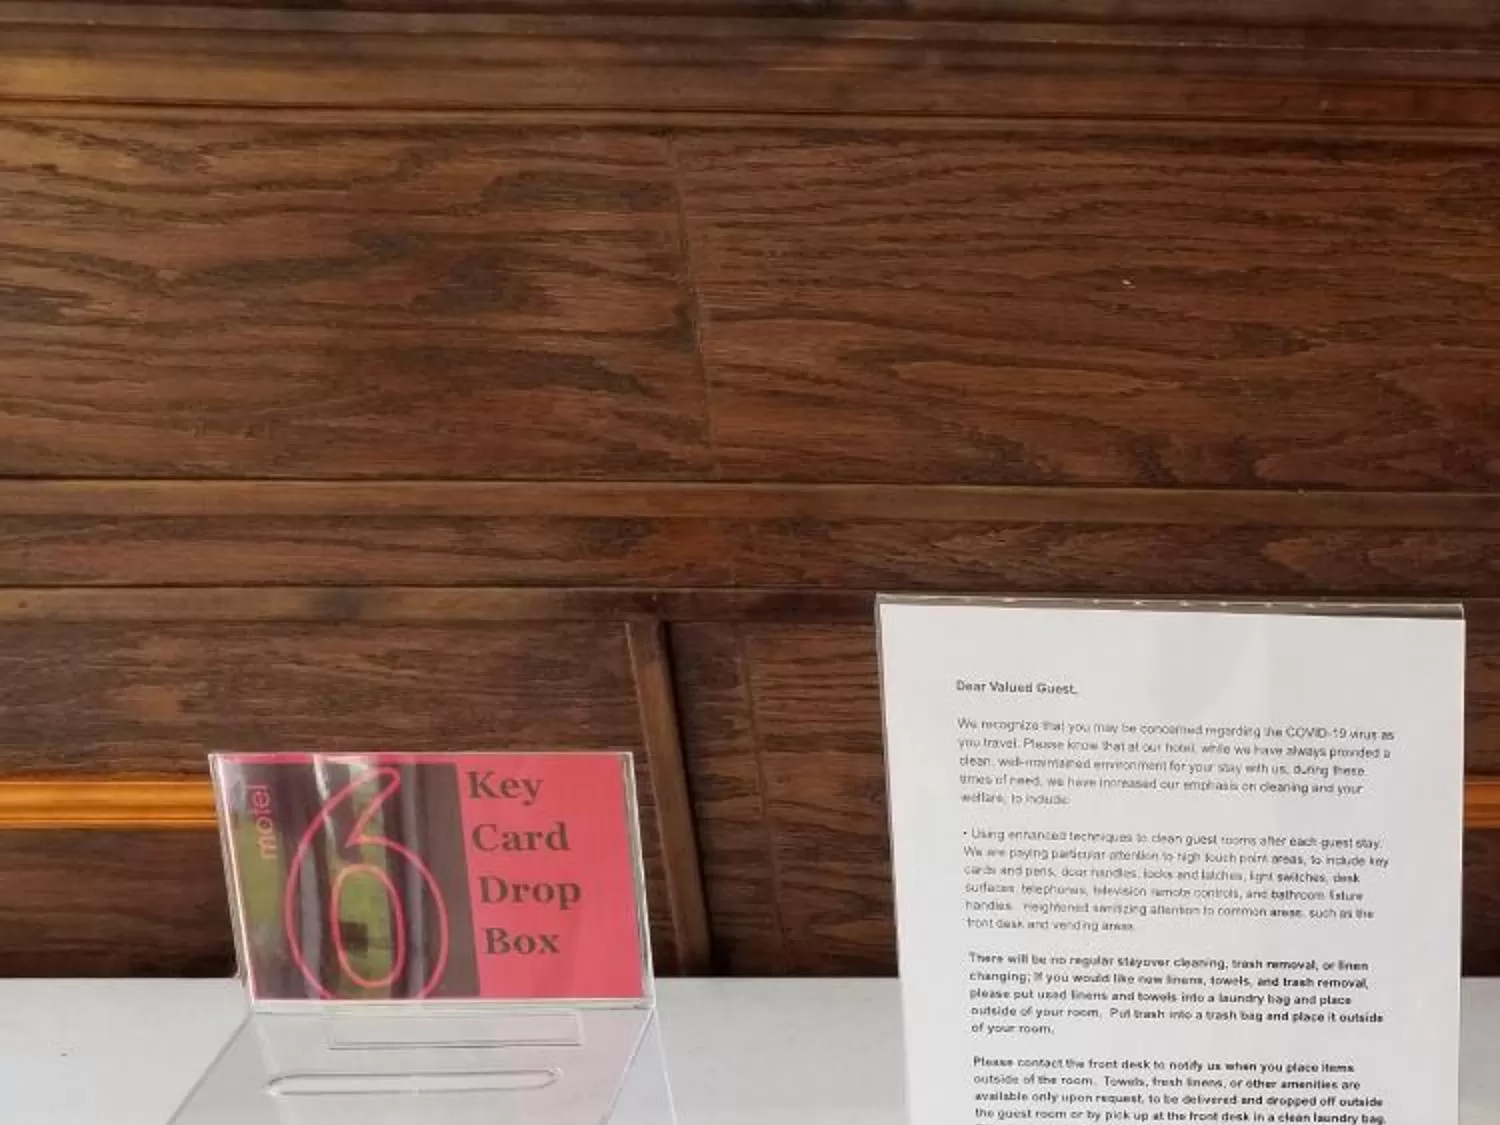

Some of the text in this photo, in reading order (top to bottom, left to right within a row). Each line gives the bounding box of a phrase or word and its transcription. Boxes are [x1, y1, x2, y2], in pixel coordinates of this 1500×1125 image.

[956, 680, 986, 691] Dear
[989, 682, 1032, 692] Valued
[465, 769, 544, 806] Key
[249, 785, 278, 860] motel
[472, 821, 570, 852] Card
[285, 766, 449, 1000] 6
[479, 875, 582, 910] Drop
[484, 927, 561, 956] Box
[976, 1108, 994, 1117] the
[998, 1110, 1031, 1120] guest
[1087, 1111, 1100, 1120] by
[1106, 1111, 1129, 1121] pick
[1134, 1113, 1148, 1122] up
[1153, 1112, 1164, 1120] at
[1167, 1112, 1186, 1120] the
[1190, 1112, 1218, 1120] front
[1222, 1112, 1248, 1121] desk
[1254, 1112, 1264, 1121] in
[1278, 1112, 1310, 1122] clean
[1362, 1114, 1385, 1125] bag.
